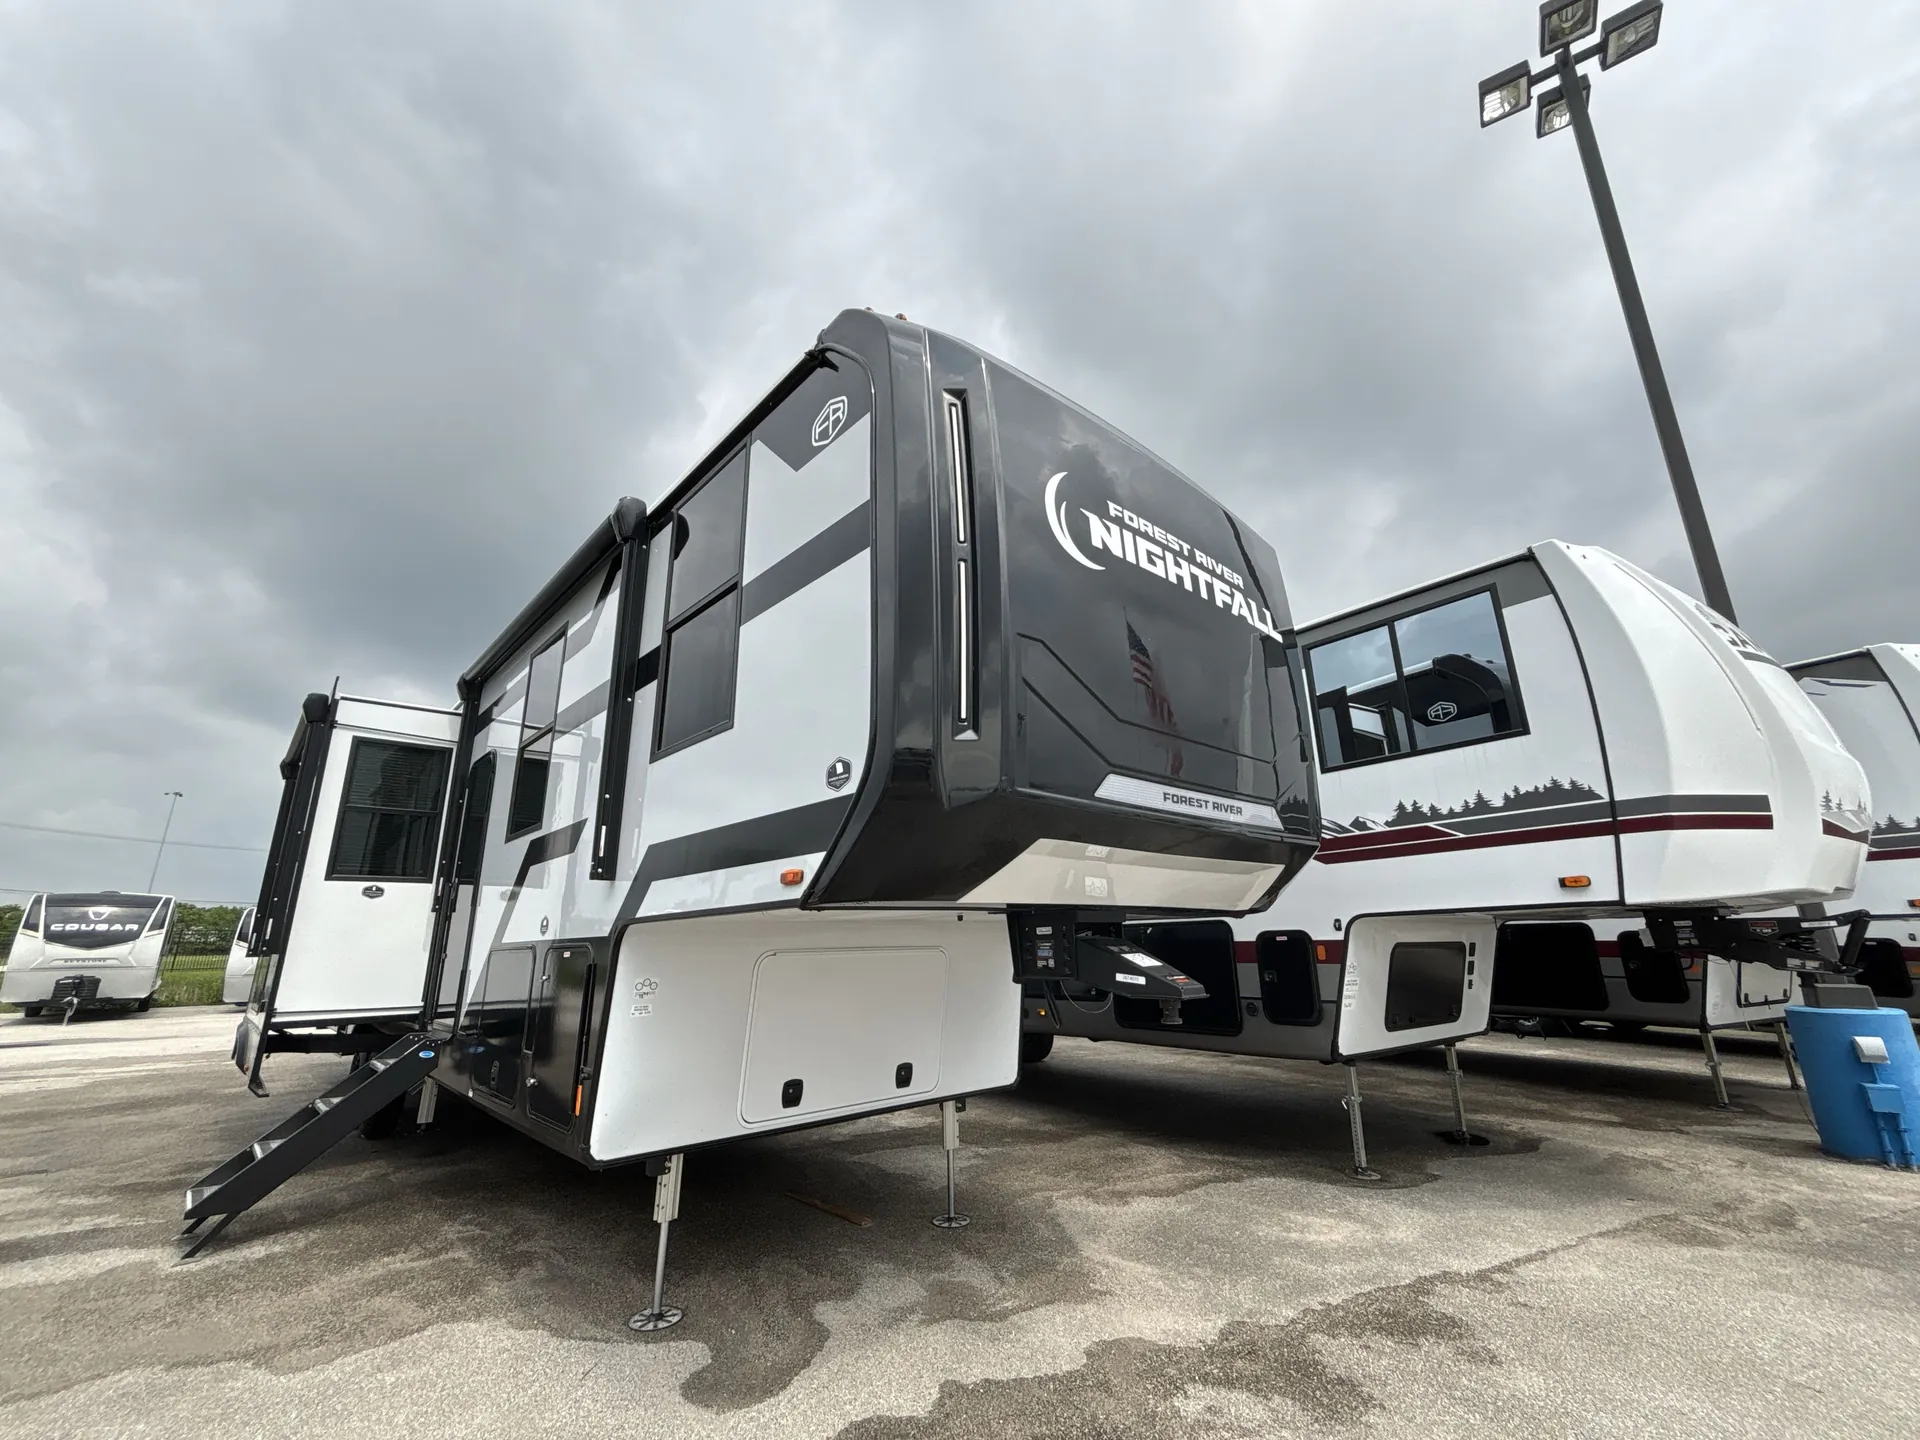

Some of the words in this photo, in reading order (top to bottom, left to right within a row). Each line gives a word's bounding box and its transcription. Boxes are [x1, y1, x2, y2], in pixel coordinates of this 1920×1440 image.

[1106, 500, 1190, 556] FOREST
[1194, 548, 1244, 589] RIVER
[1080, 508, 1283, 643] NIGHTFALL
[1163, 792, 1210, 810] FOREST
[1212, 802, 1243, 815] RIVER
[50, 923, 139, 931] COUGAR
